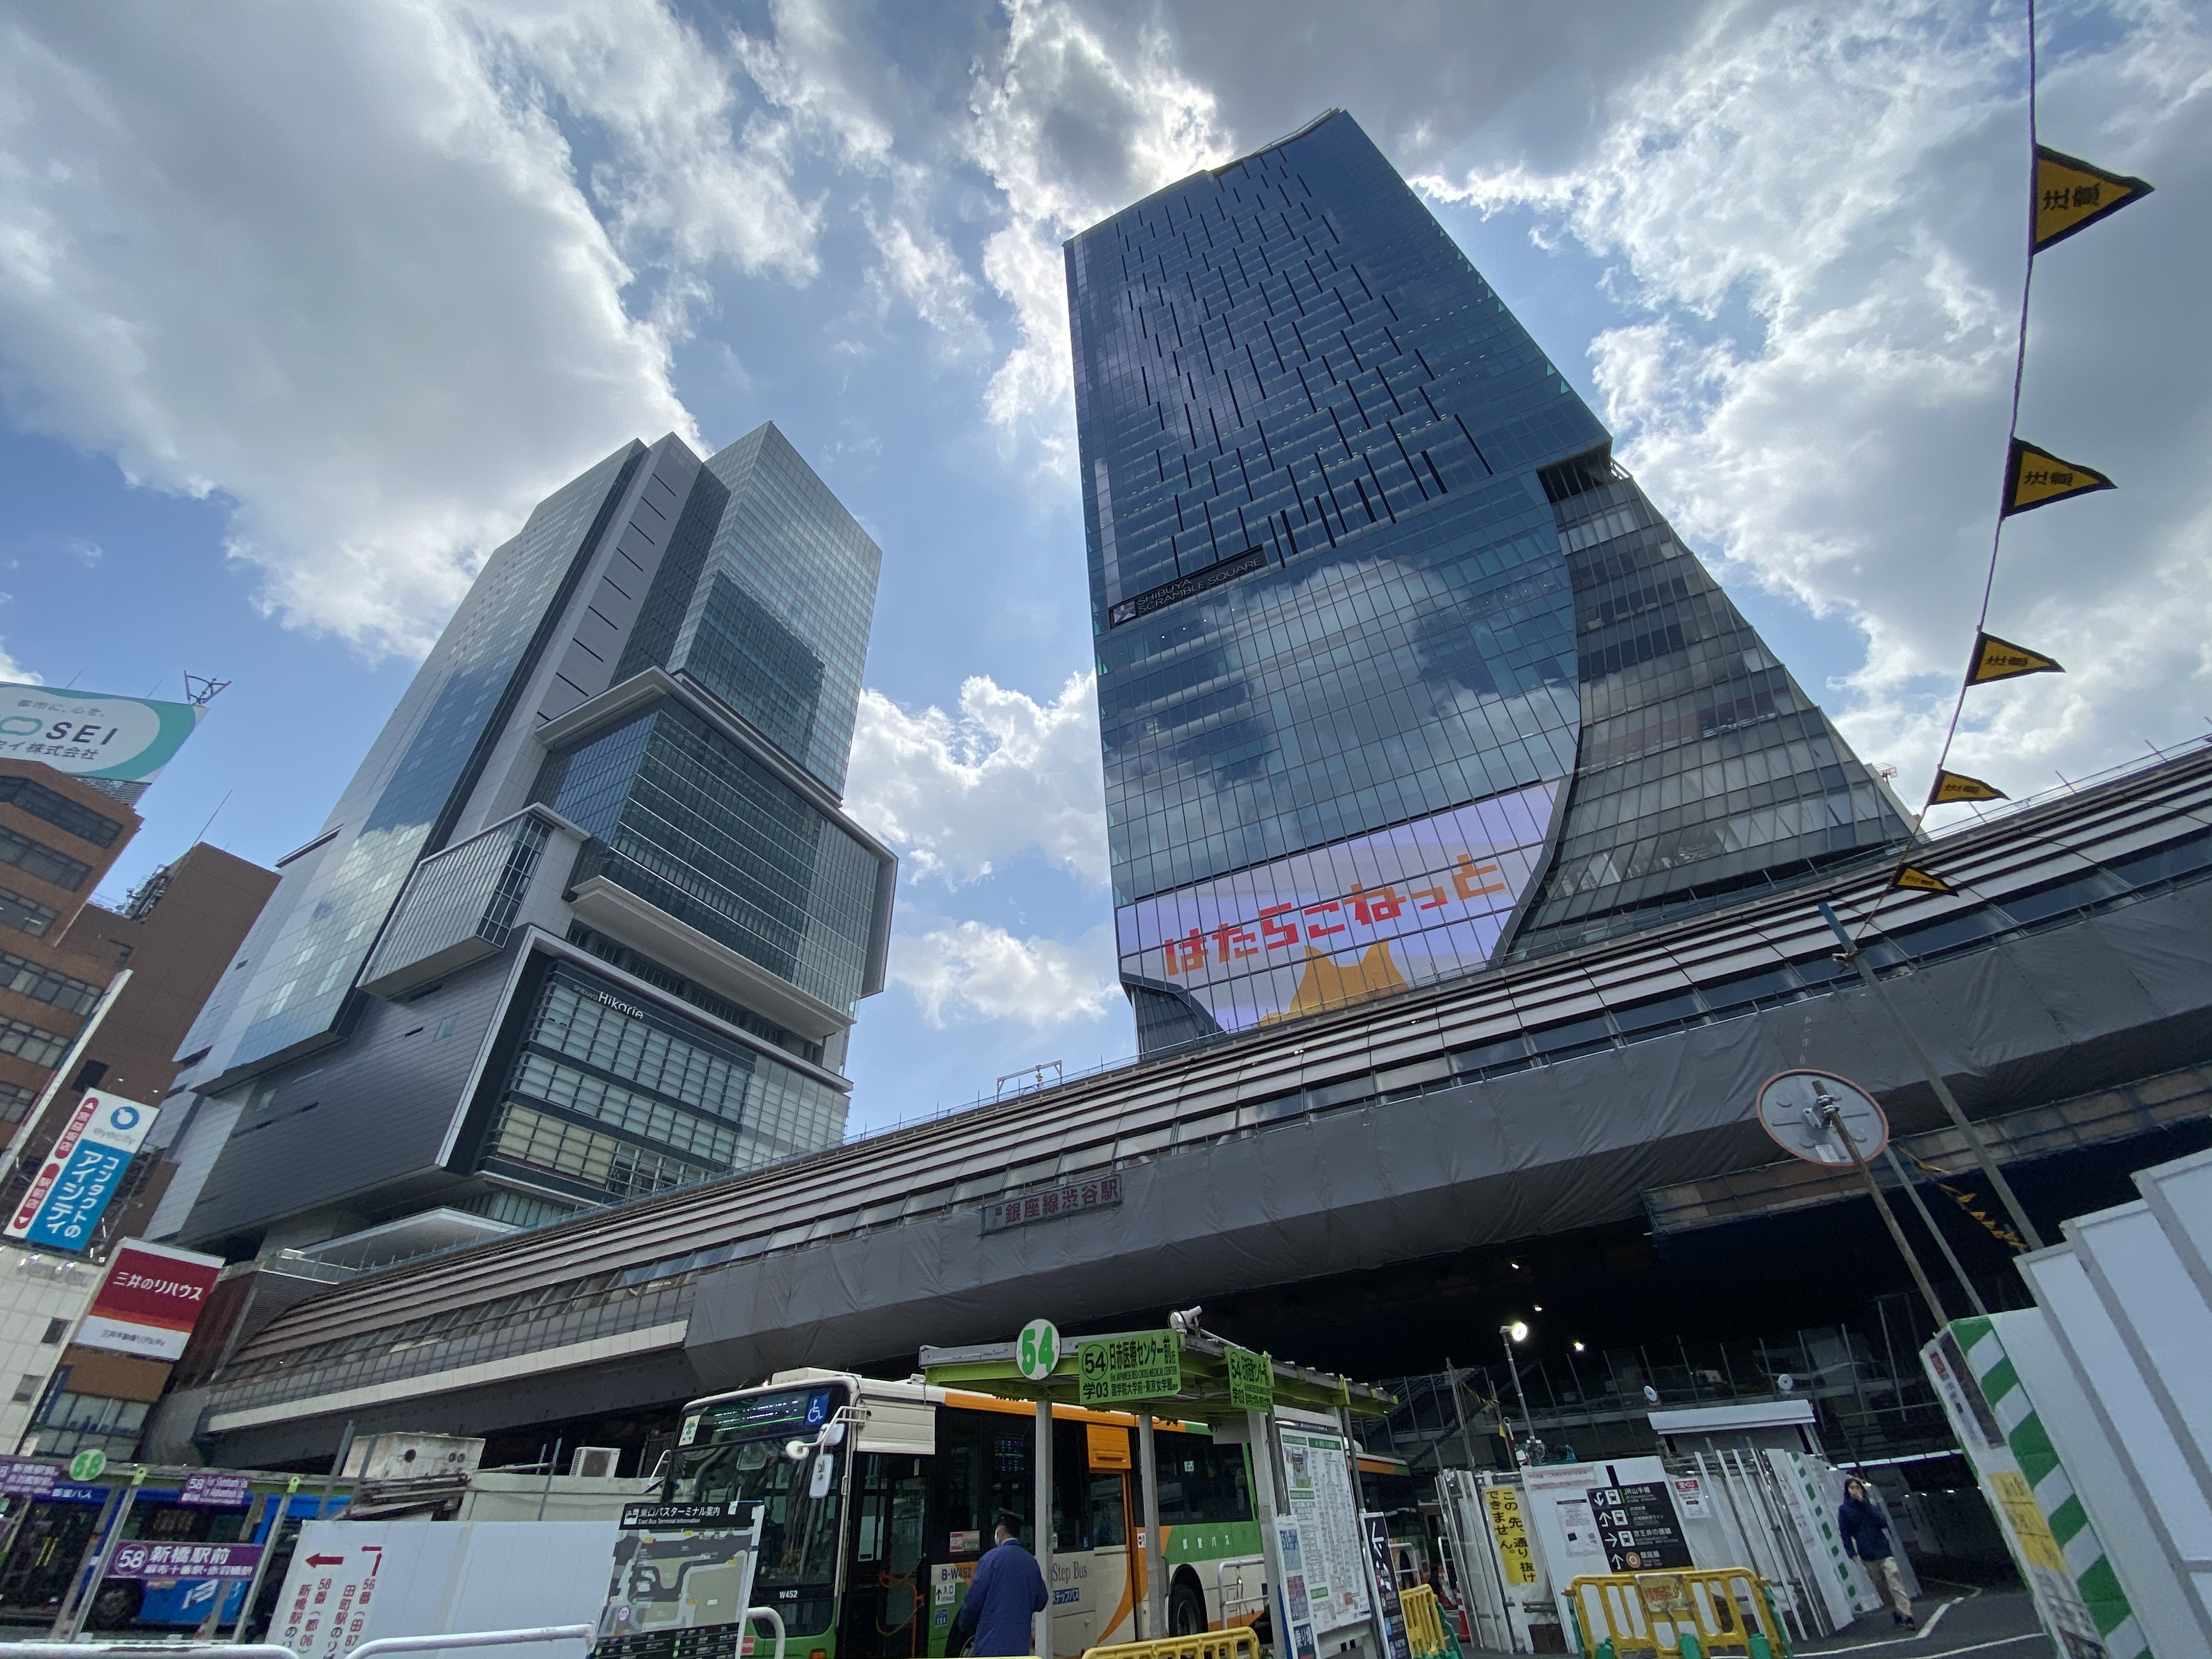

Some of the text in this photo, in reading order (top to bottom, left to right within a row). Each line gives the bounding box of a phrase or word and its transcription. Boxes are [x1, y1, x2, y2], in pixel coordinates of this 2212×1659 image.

[2042, 182, 2101, 211] 注意
[2024, 471, 2073, 486] 注意
[1137, 579, 1192, 605] SHIBUYA
[1139, 557, 1262, 613] SCRAMBLE SQUARE
[1165, 853, 1506, 977] はたらこねっと
[573, 985, 644, 1019] Shibuya Hikarie
[93, 1128, 137, 1147] eyecity
[46, 1150, 103, 1234] アイシティ
[64, 1156, 120, 1238] コンタクトの
[1005, 1179, 1119, 1224] 銀座線渋谷駅
[113, 1271, 204, 1301] 三井のリハウス
[1022, 1325, 1055, 1376] 54
[1085, 1351, 1106, 1374] 54
[1231, 1358, 1241, 1380] 54
[1083, 1381, 1109, 1400] 学03
[639, 1505, 721, 1517] 東口バスターミナル案内
[1486, 1491, 1515, 1554] できません。
[1504, 1492, 1536, 1583] この先、通り抜け
[117, 1549, 145, 1568] 58
[149, 1545, 231, 1564] 新橋駅前
[941, 1567, 972, 1581] B-W452
[1053, 1561, 1088, 1584] Step Bus
[780, 1590, 798, 1599] W452
